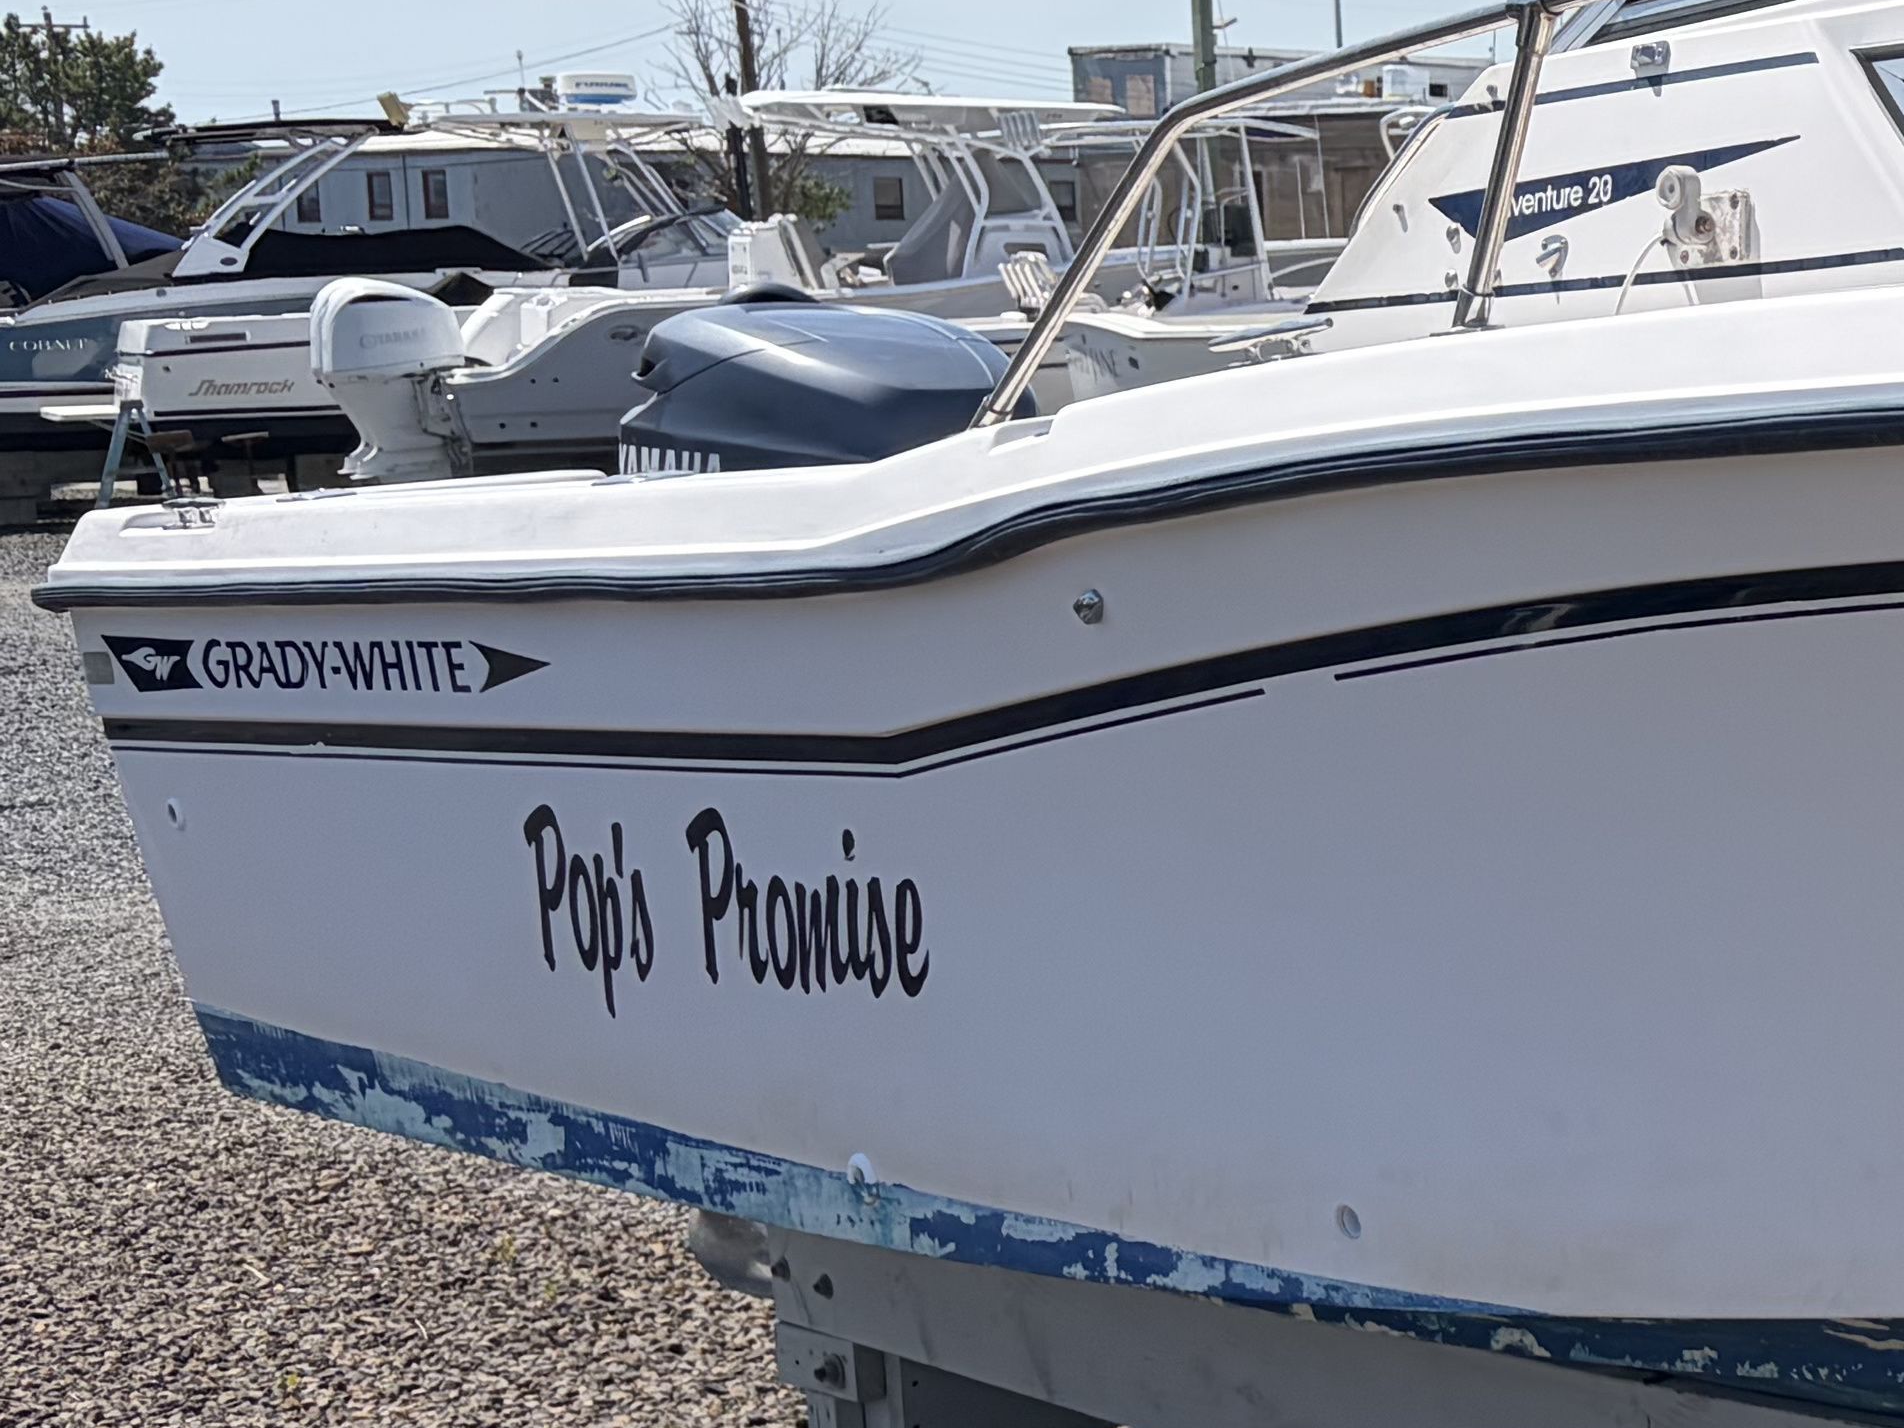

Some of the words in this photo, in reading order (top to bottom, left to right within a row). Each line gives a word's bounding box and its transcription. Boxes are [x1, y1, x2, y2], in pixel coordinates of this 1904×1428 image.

[1510, 184, 1583, 217] venture
[1587, 174, 1612, 204] 20
[188, 378, 295, 397] Shamrock
[202, 638, 472, 692] GRADY-WHITE
[523, 803, 654, 1019] Pop's
[685, 807, 929, 998] Promise
